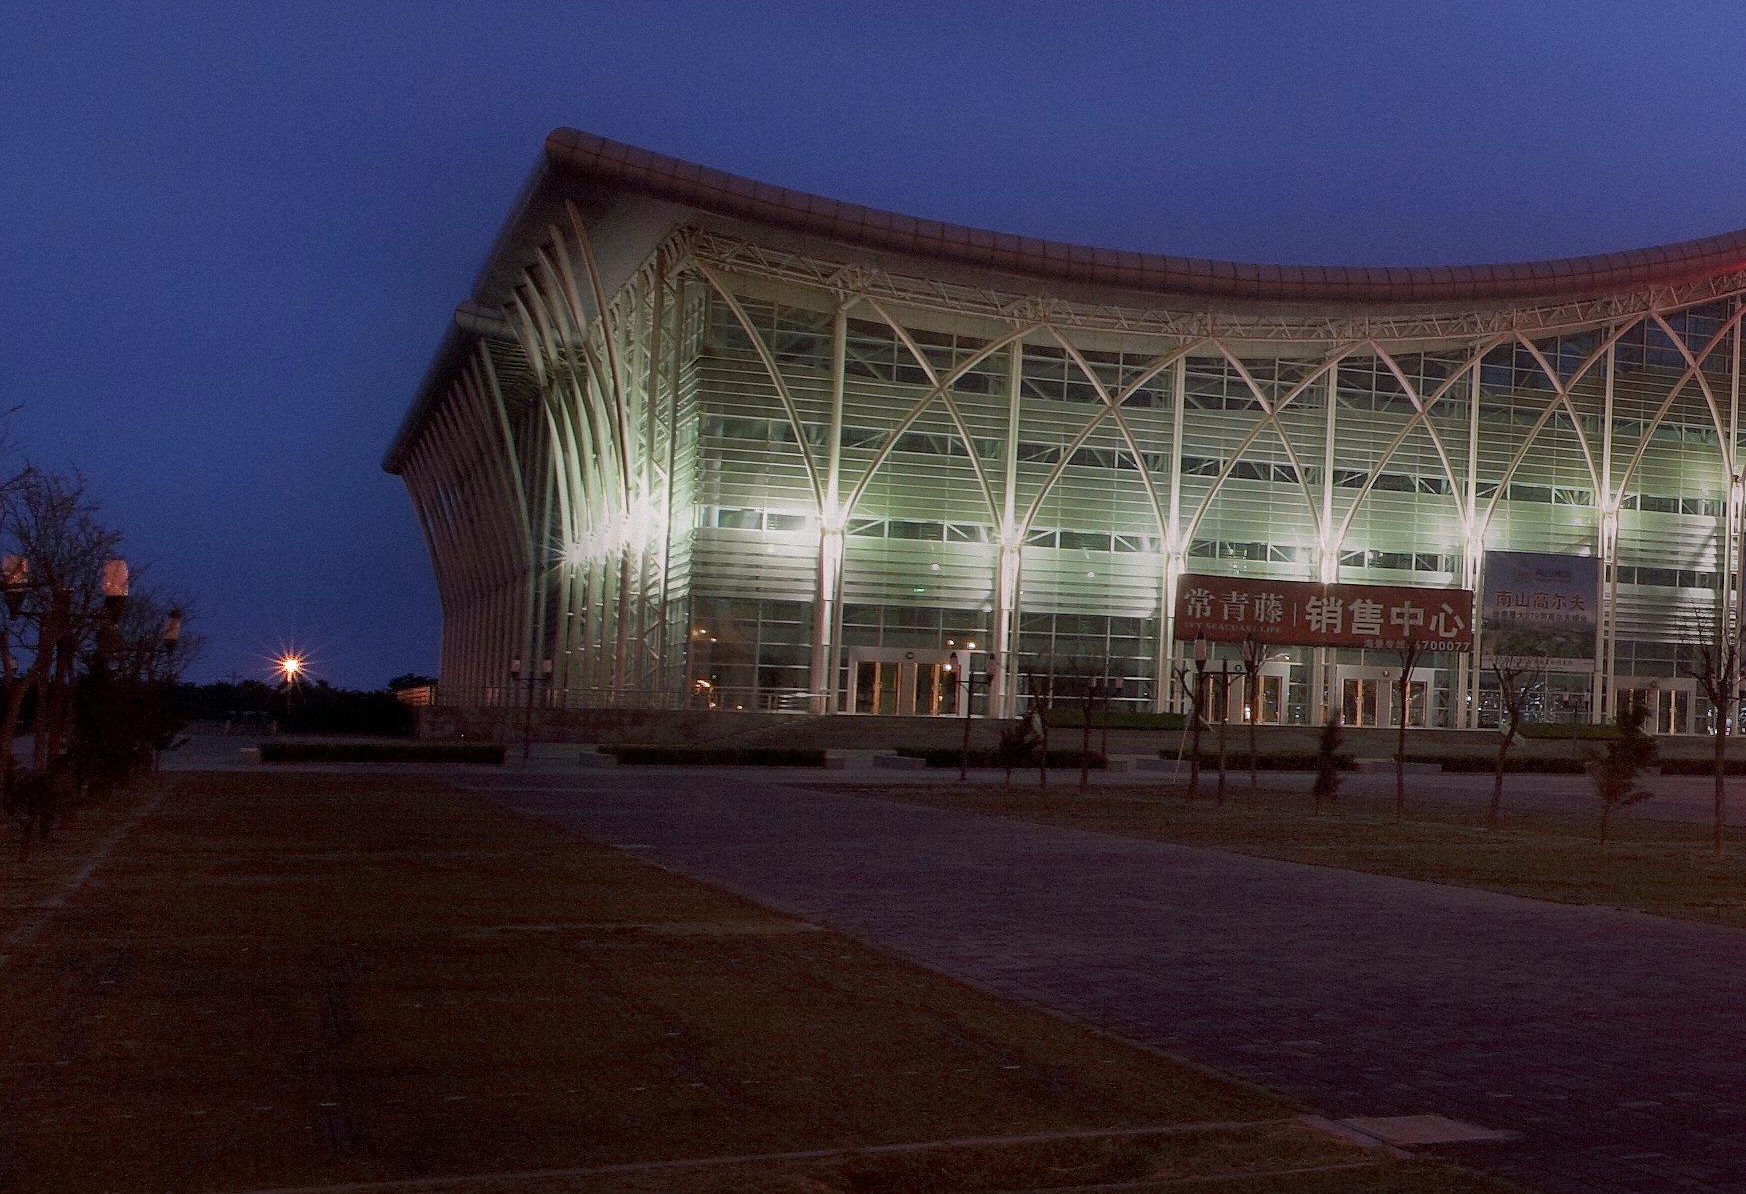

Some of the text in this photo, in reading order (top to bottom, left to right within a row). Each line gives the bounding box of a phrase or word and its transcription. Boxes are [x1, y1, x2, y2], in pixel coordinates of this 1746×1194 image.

[1184, 587, 1464, 638] 常青藤 销售中心
[1496, 590, 1585, 611] 南山高尔夫
